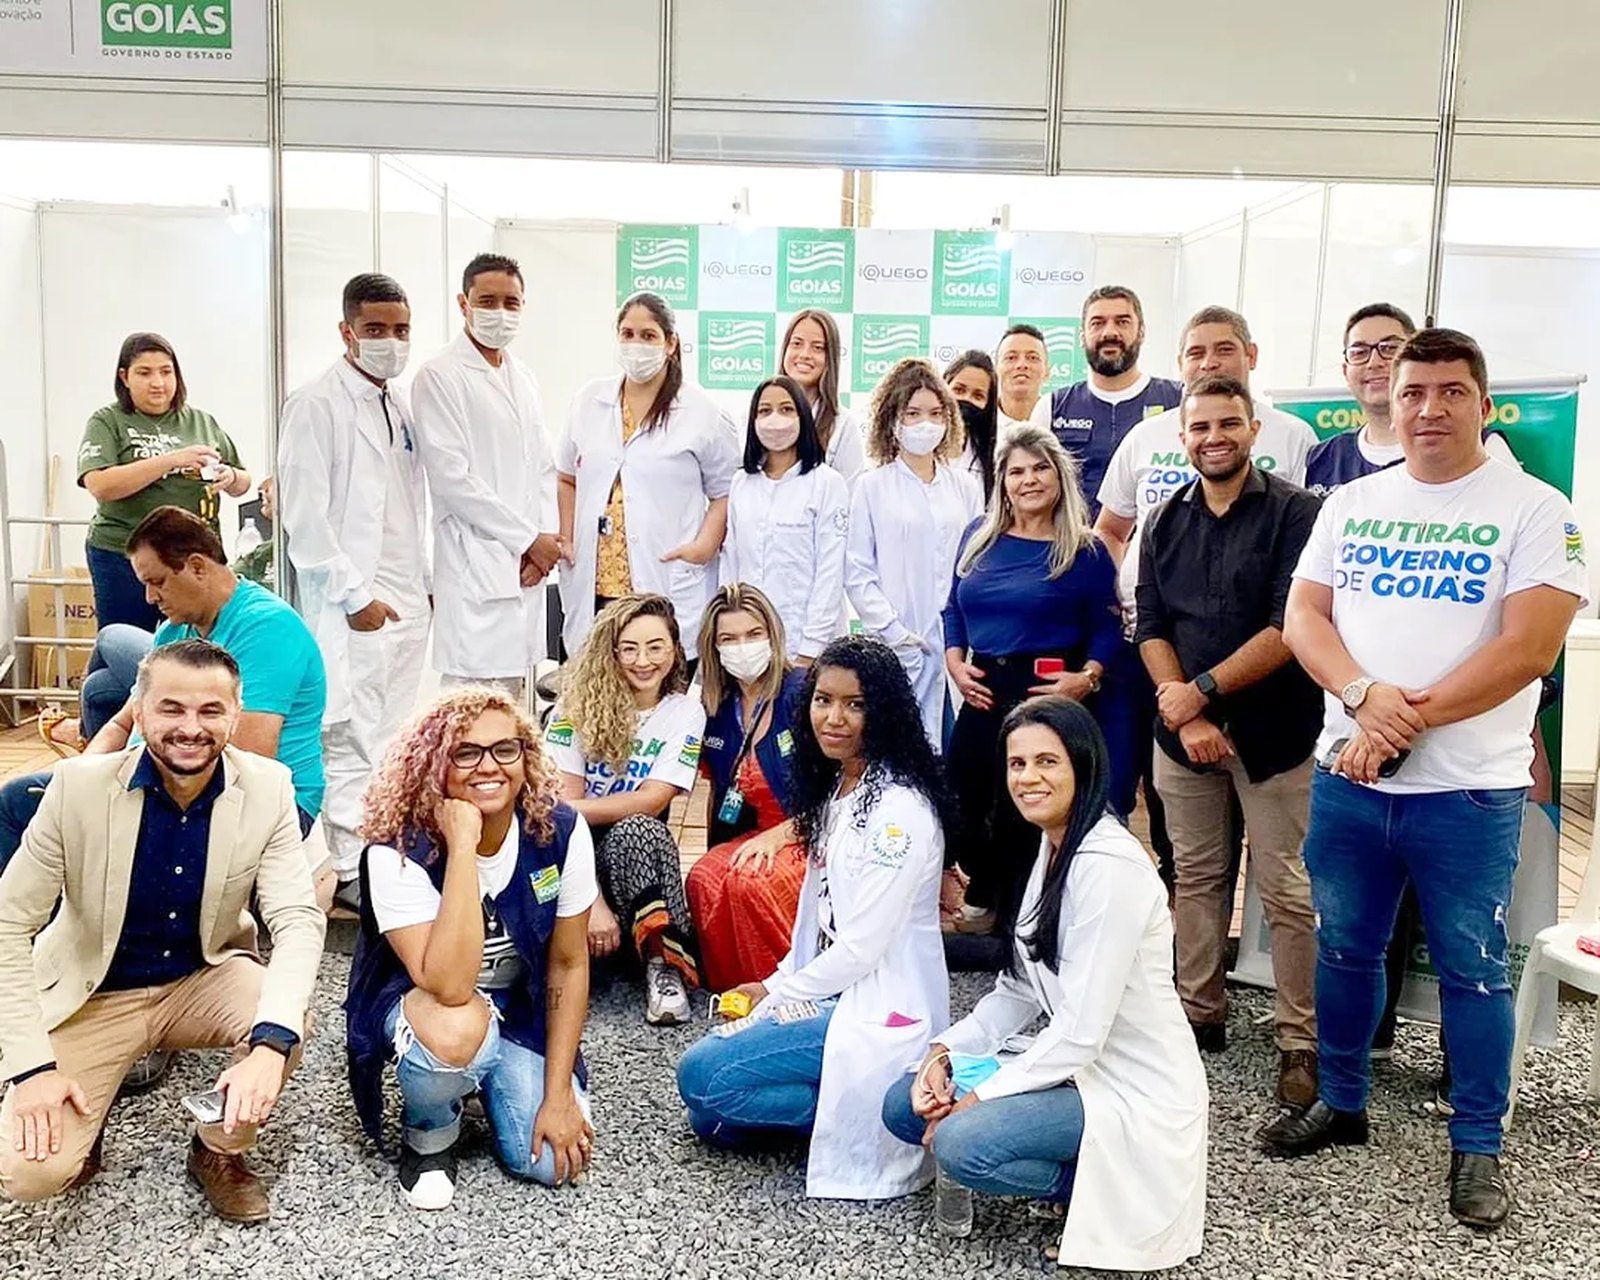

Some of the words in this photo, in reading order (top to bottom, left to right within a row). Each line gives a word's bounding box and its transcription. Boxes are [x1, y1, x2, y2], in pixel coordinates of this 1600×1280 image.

[106, 2, 226, 35] GOIÁS
[102, 48, 160, 58] GOVERNO
[165, 50, 181, 58] DO
[187, 51, 232, 60] ESTADO
[1343, 518, 1500, 546] MUTIRÃO
[1341, 542, 1491, 575] GOVERNO
[1371, 573, 1486, 604] GOIÁS
